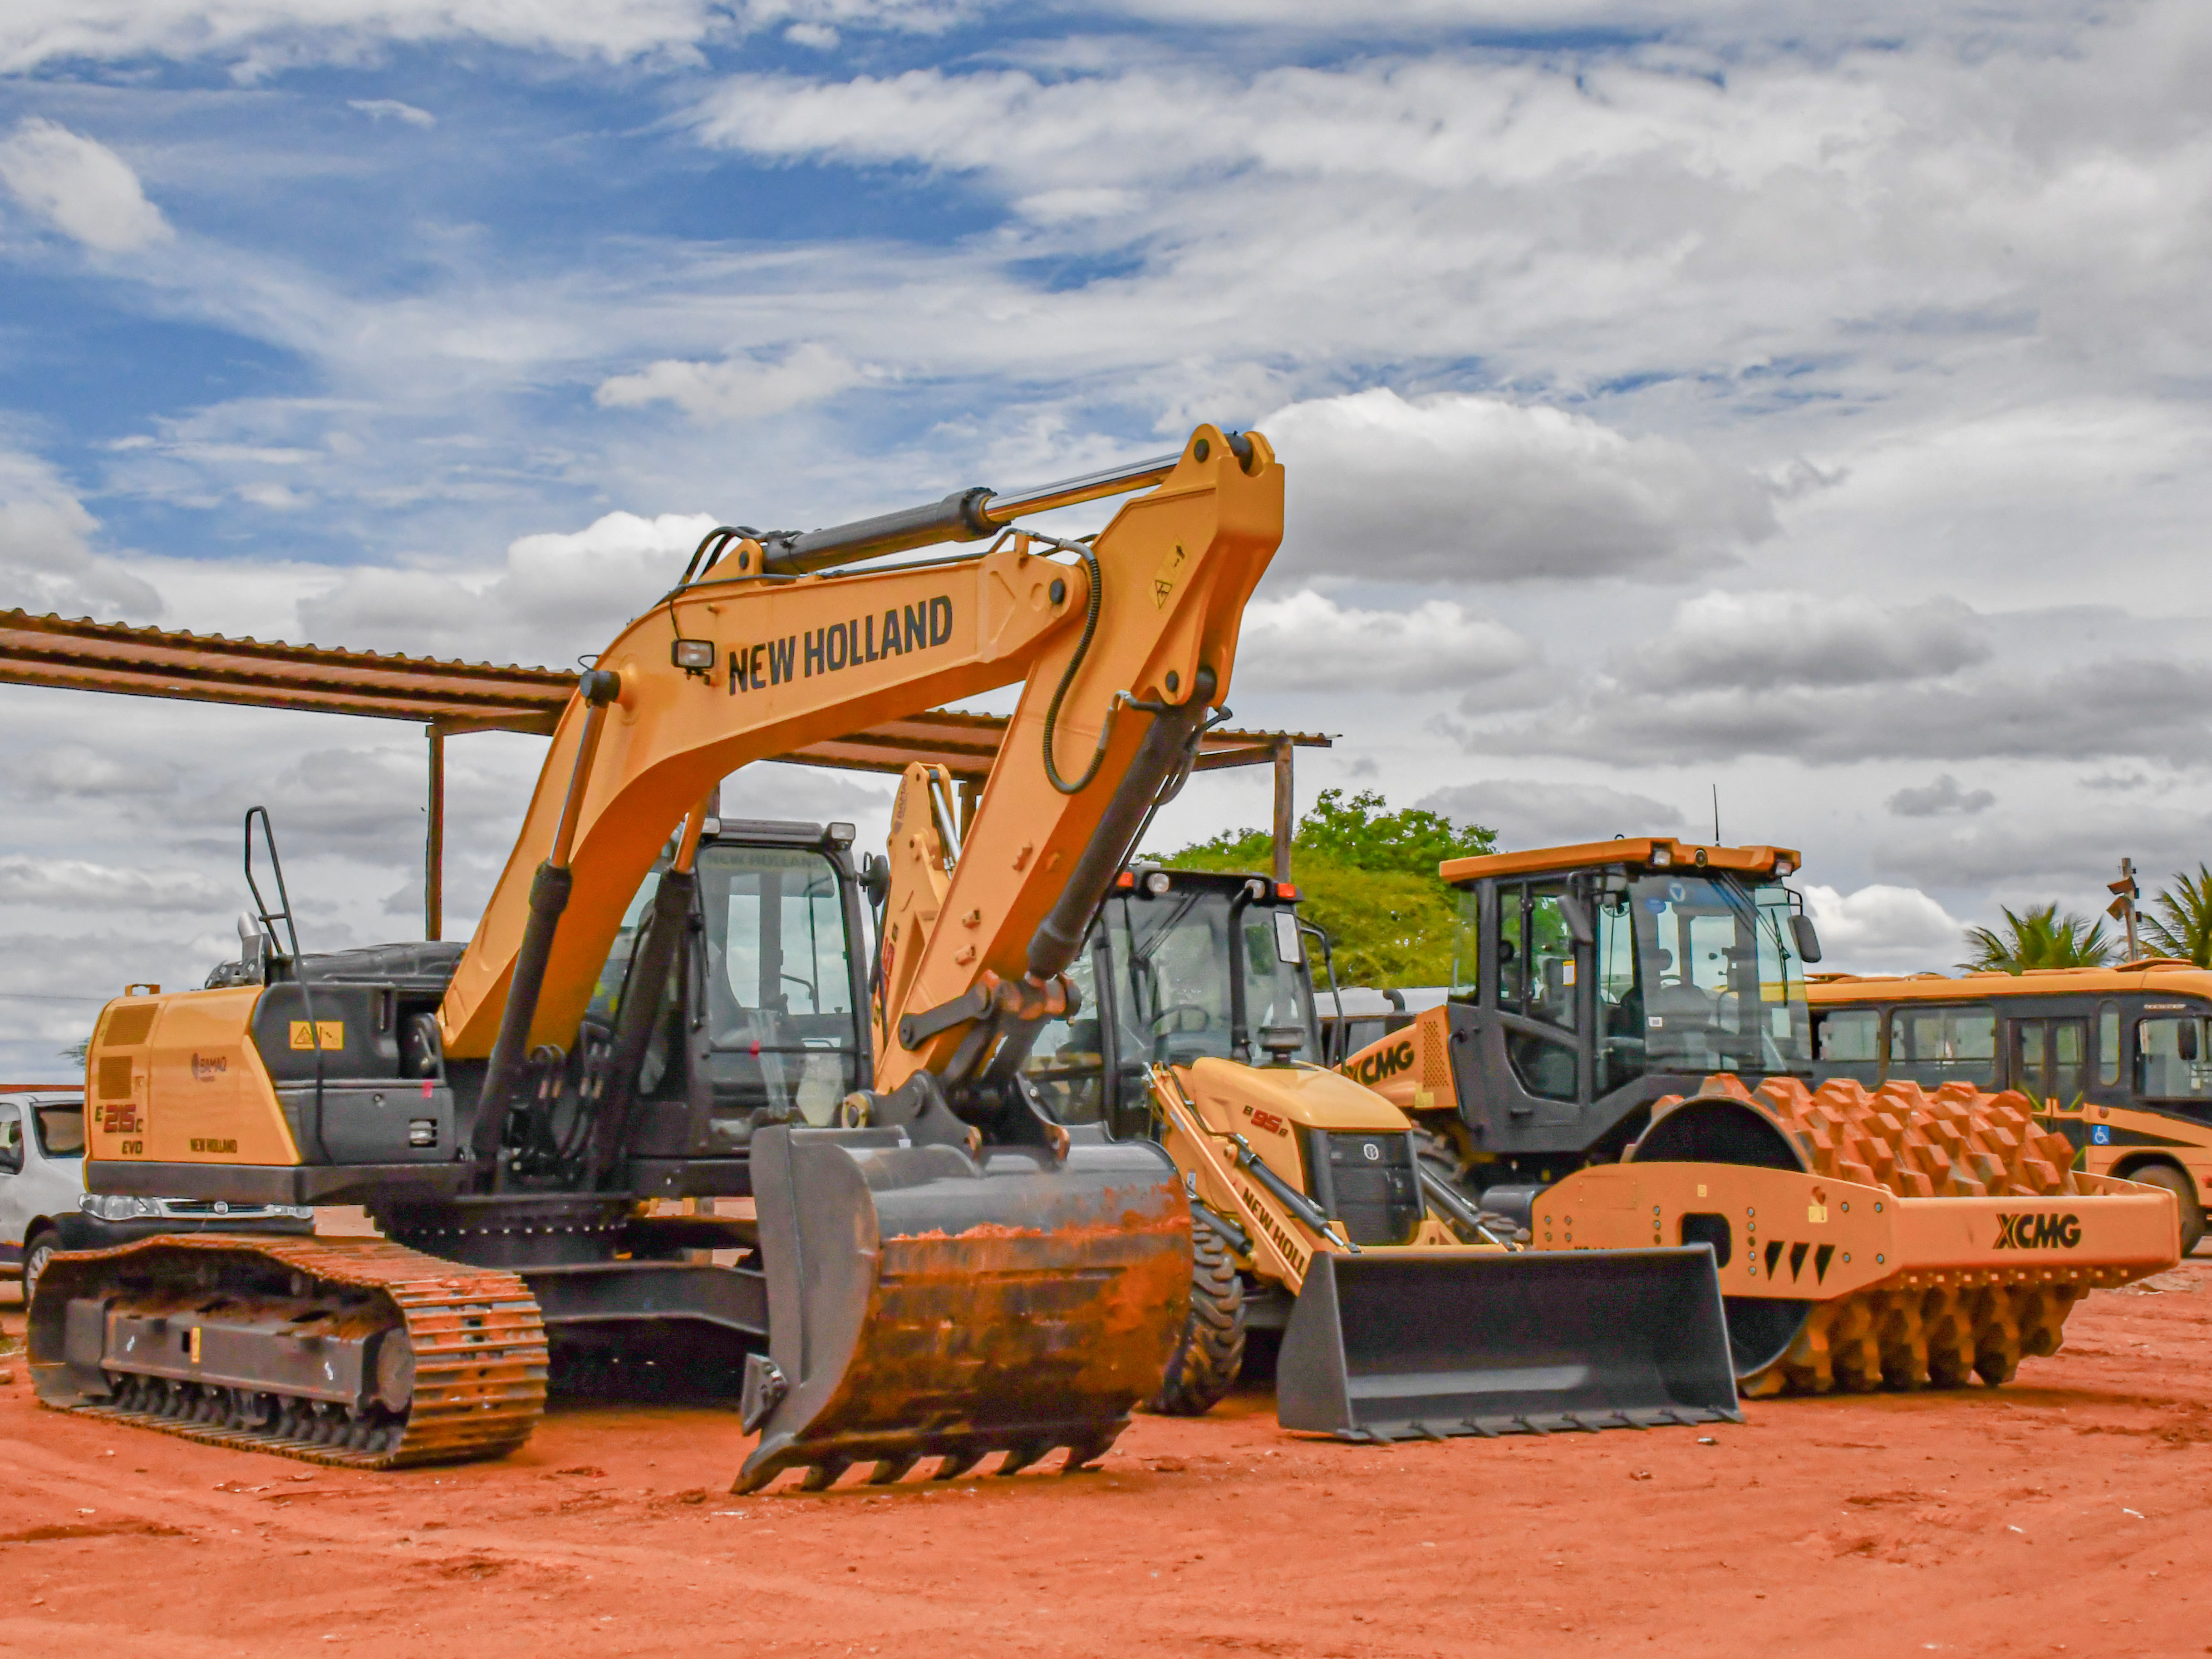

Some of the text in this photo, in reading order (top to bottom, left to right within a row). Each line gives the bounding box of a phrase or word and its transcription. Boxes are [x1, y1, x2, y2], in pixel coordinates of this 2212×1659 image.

[729, 595, 953, 696] NEW HOLLAND
[122, 1140, 143, 1154] EVO
[190, 1138, 206, 1152] NEW
[1243, 1187, 1305, 1276] NEW HOLL
[1993, 1213, 2081, 1249] XCMG
